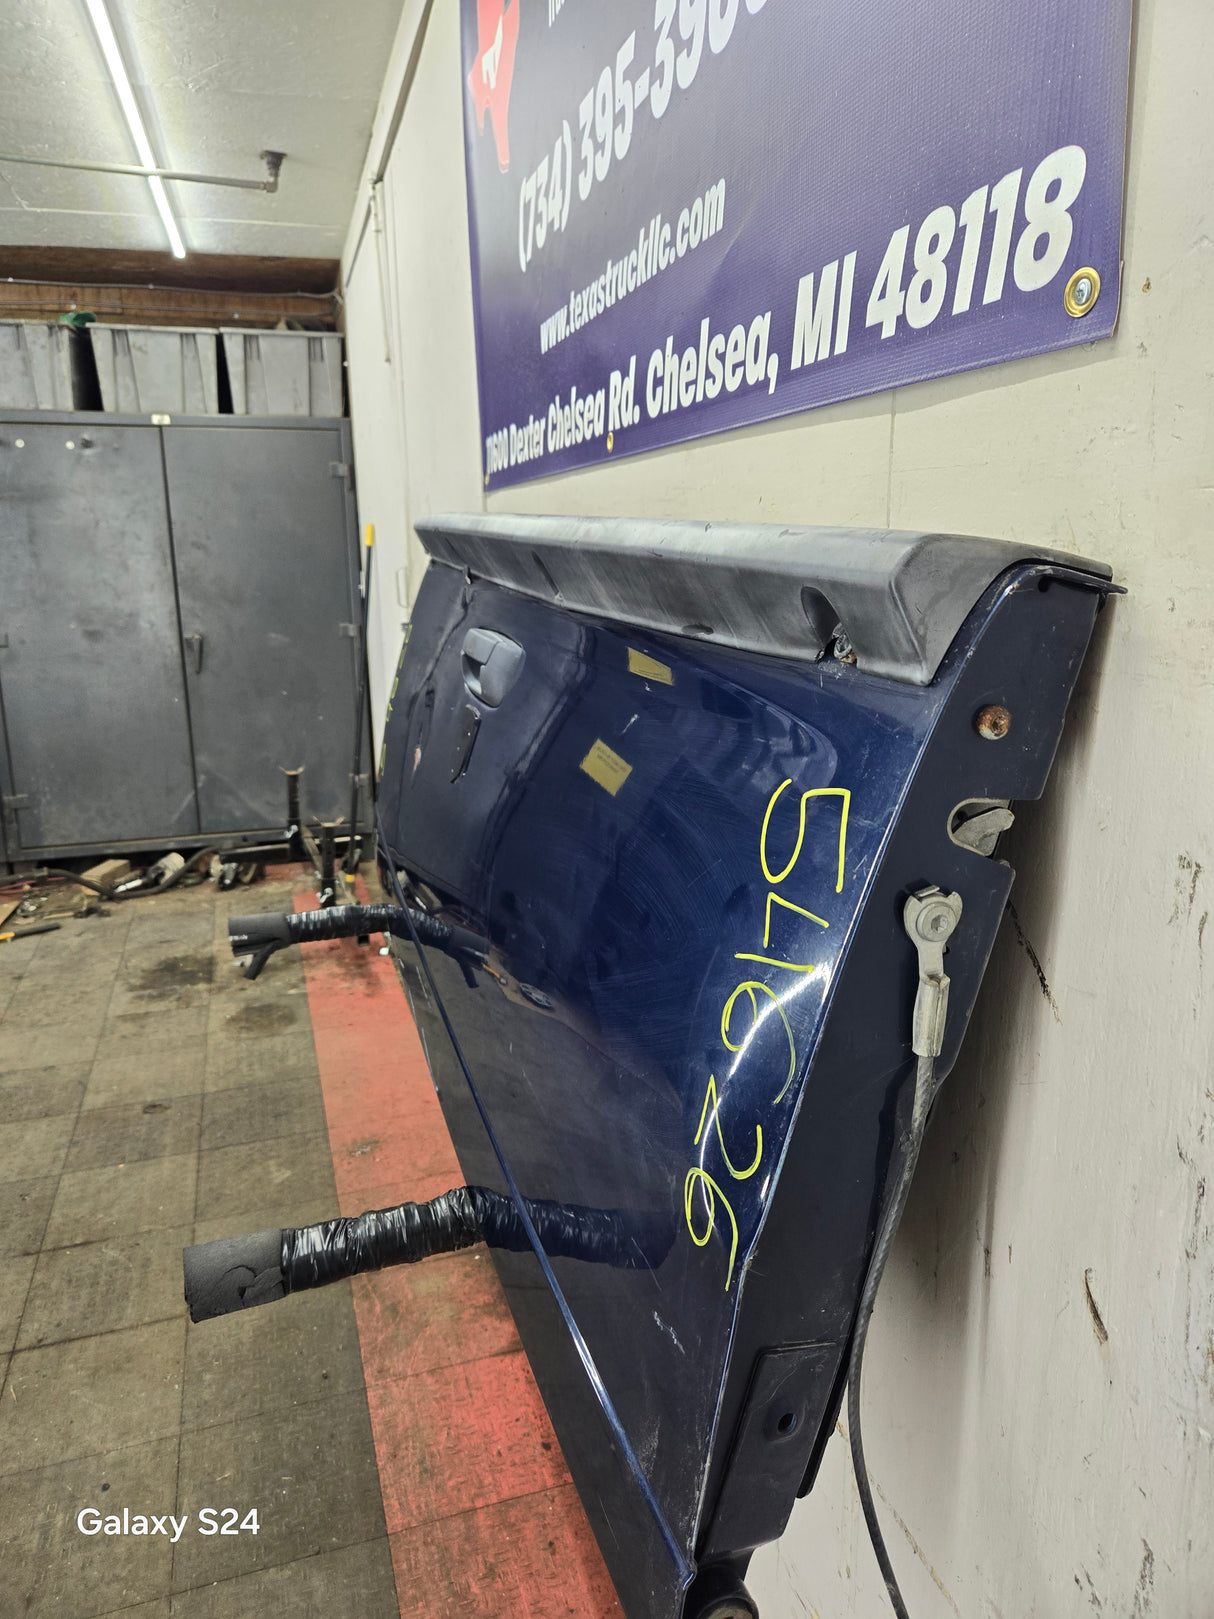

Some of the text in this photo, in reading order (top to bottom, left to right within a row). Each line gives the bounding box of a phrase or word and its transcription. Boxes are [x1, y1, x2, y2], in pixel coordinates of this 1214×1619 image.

[519, 119, 572, 272] (734)
[540, 178, 726, 355] www.texastruckllc.com
[509, 415, 546, 467] Dexter
[547, 386, 605, 453] Chelsea
[608, 355, 641, 432] Rd.
[646, 311, 779, 419] Chelsea,
[790, 250, 858, 371] MI
[865, 145, 1088, 340] 48118
